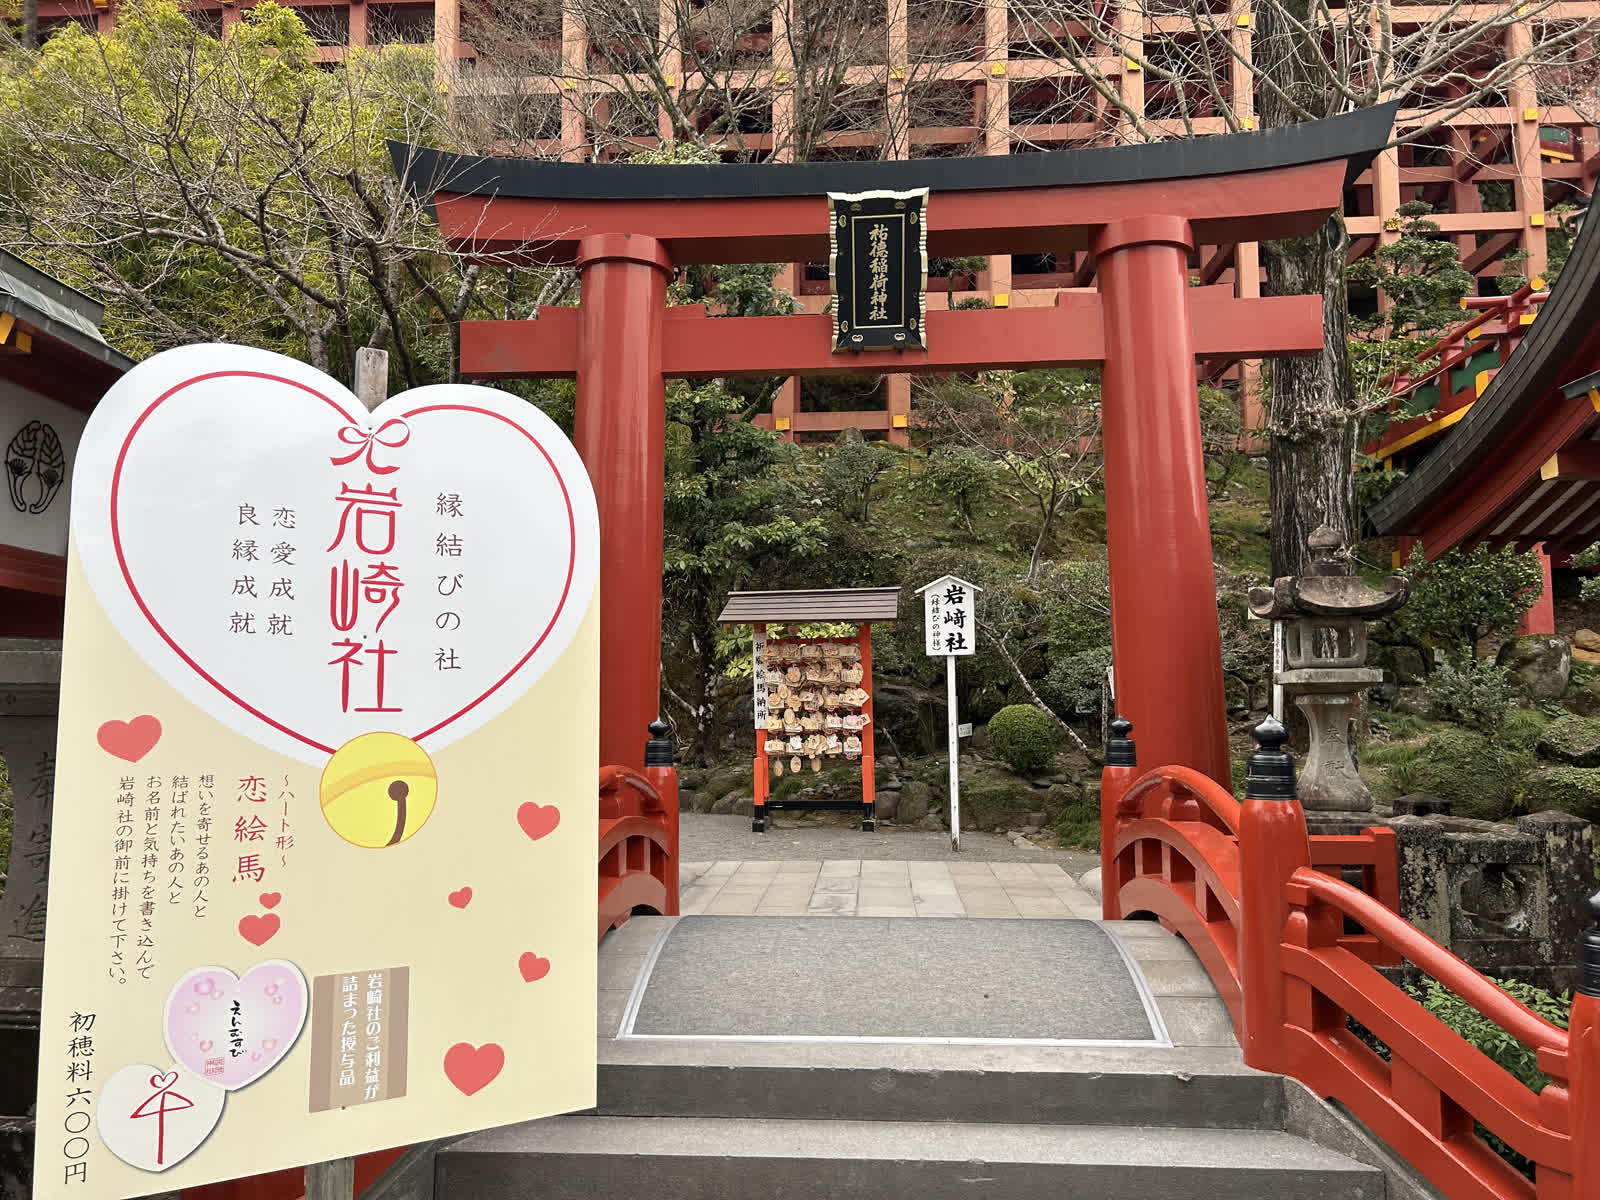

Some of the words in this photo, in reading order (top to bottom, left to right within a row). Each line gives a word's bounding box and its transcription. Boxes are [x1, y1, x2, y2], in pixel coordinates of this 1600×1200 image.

[228, 502, 260, 636] 良縁成就
[265, 505, 297, 637] 恋愛成就
[326, 482, 405, 714] 岩崎社
[433, 491, 465, 672] 縁結びの社
[109, 776, 136, 985] 岩崎社の御前に掛けて下さい。
[136, 775, 163, 980] お名前と気持ちを書き込んで
[168, 775, 189, 905] 結ばれたいあの人と
[193, 774, 215, 918] 想いを寄せるあの人と
[232, 775, 268, 883] 恋絵馬
[229, 1000, 248, 1058] えんむすび
[339, 975, 359, 1088] 詰まった授与品
